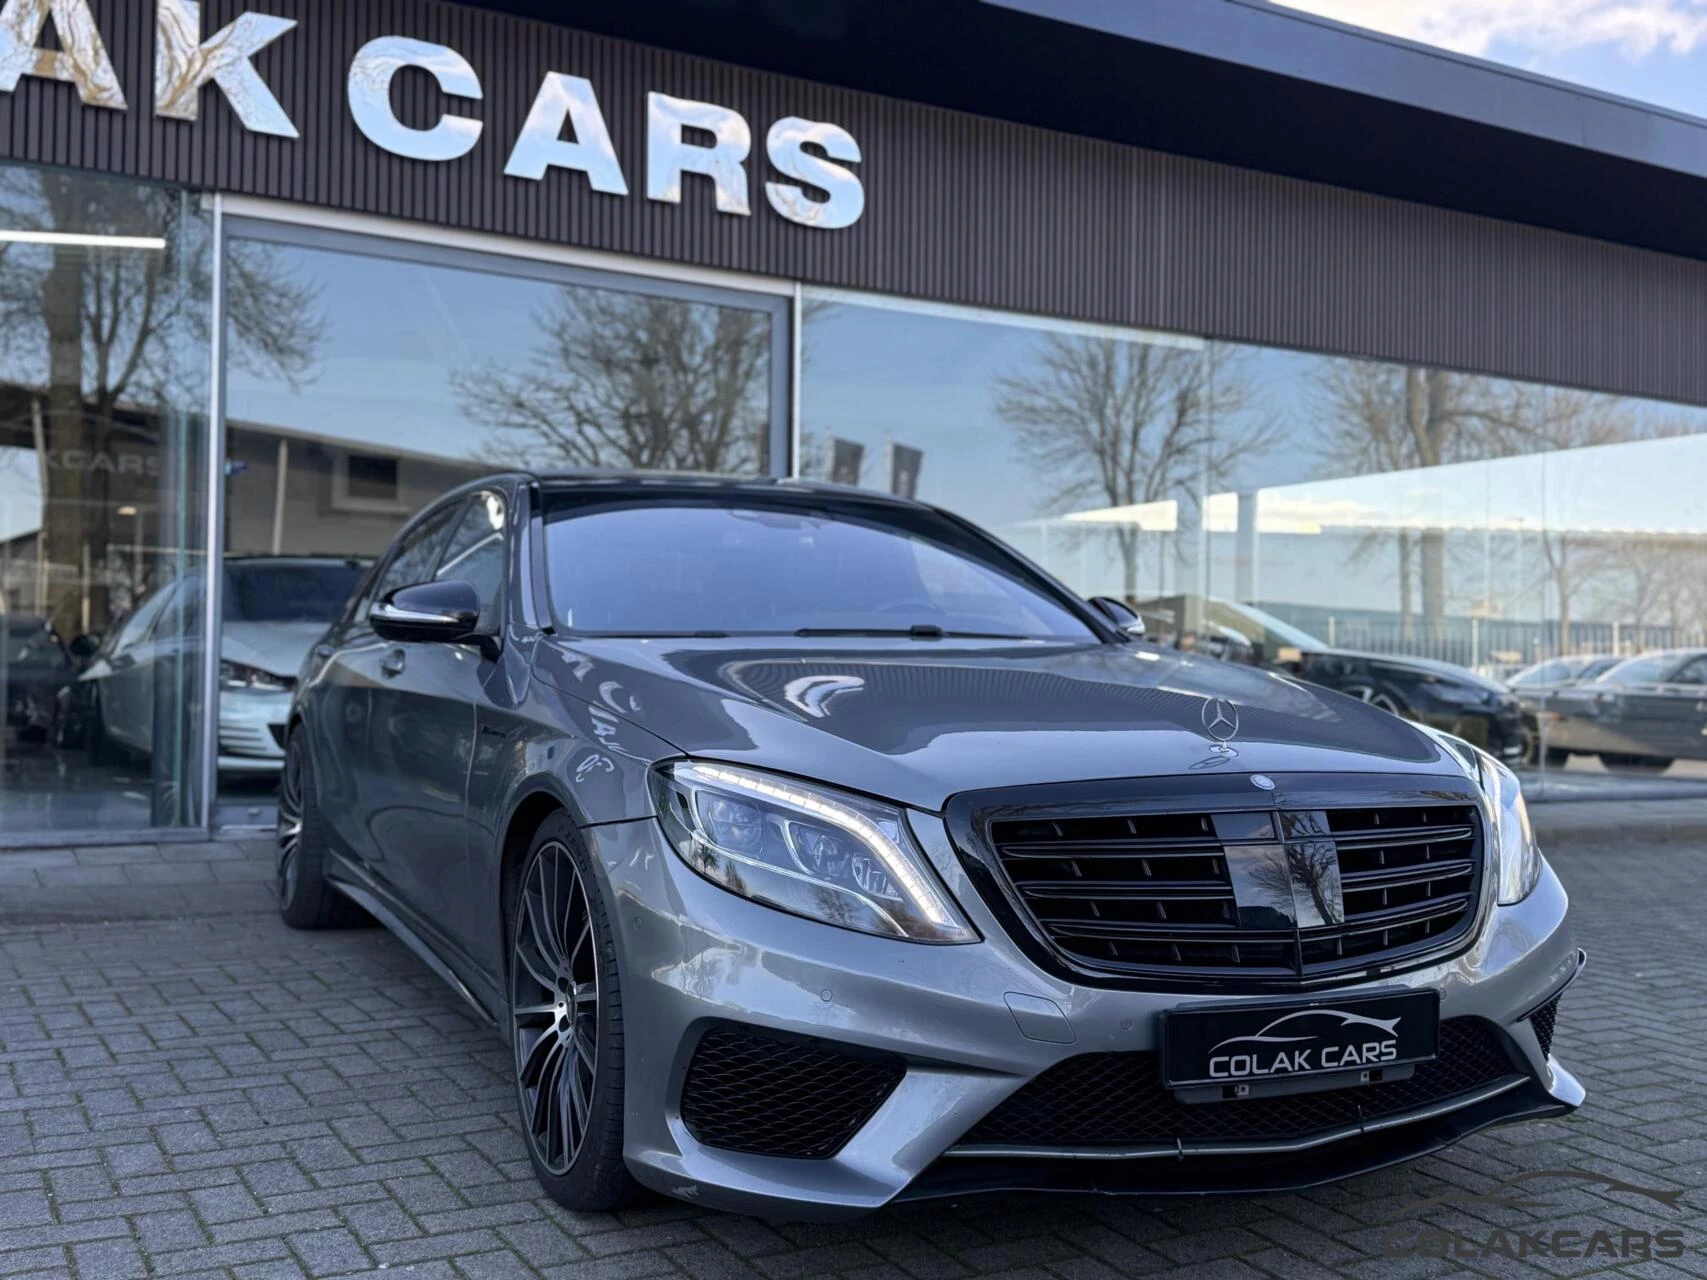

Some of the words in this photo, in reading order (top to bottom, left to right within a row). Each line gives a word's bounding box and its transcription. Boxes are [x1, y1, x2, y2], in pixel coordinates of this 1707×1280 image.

[0, 0, 300, 138] AK
[347, 36, 865, 230] CARS
[1209, 1049, 1312, 1078] COLAK
[1320, 1039, 1397, 1067] CARS
